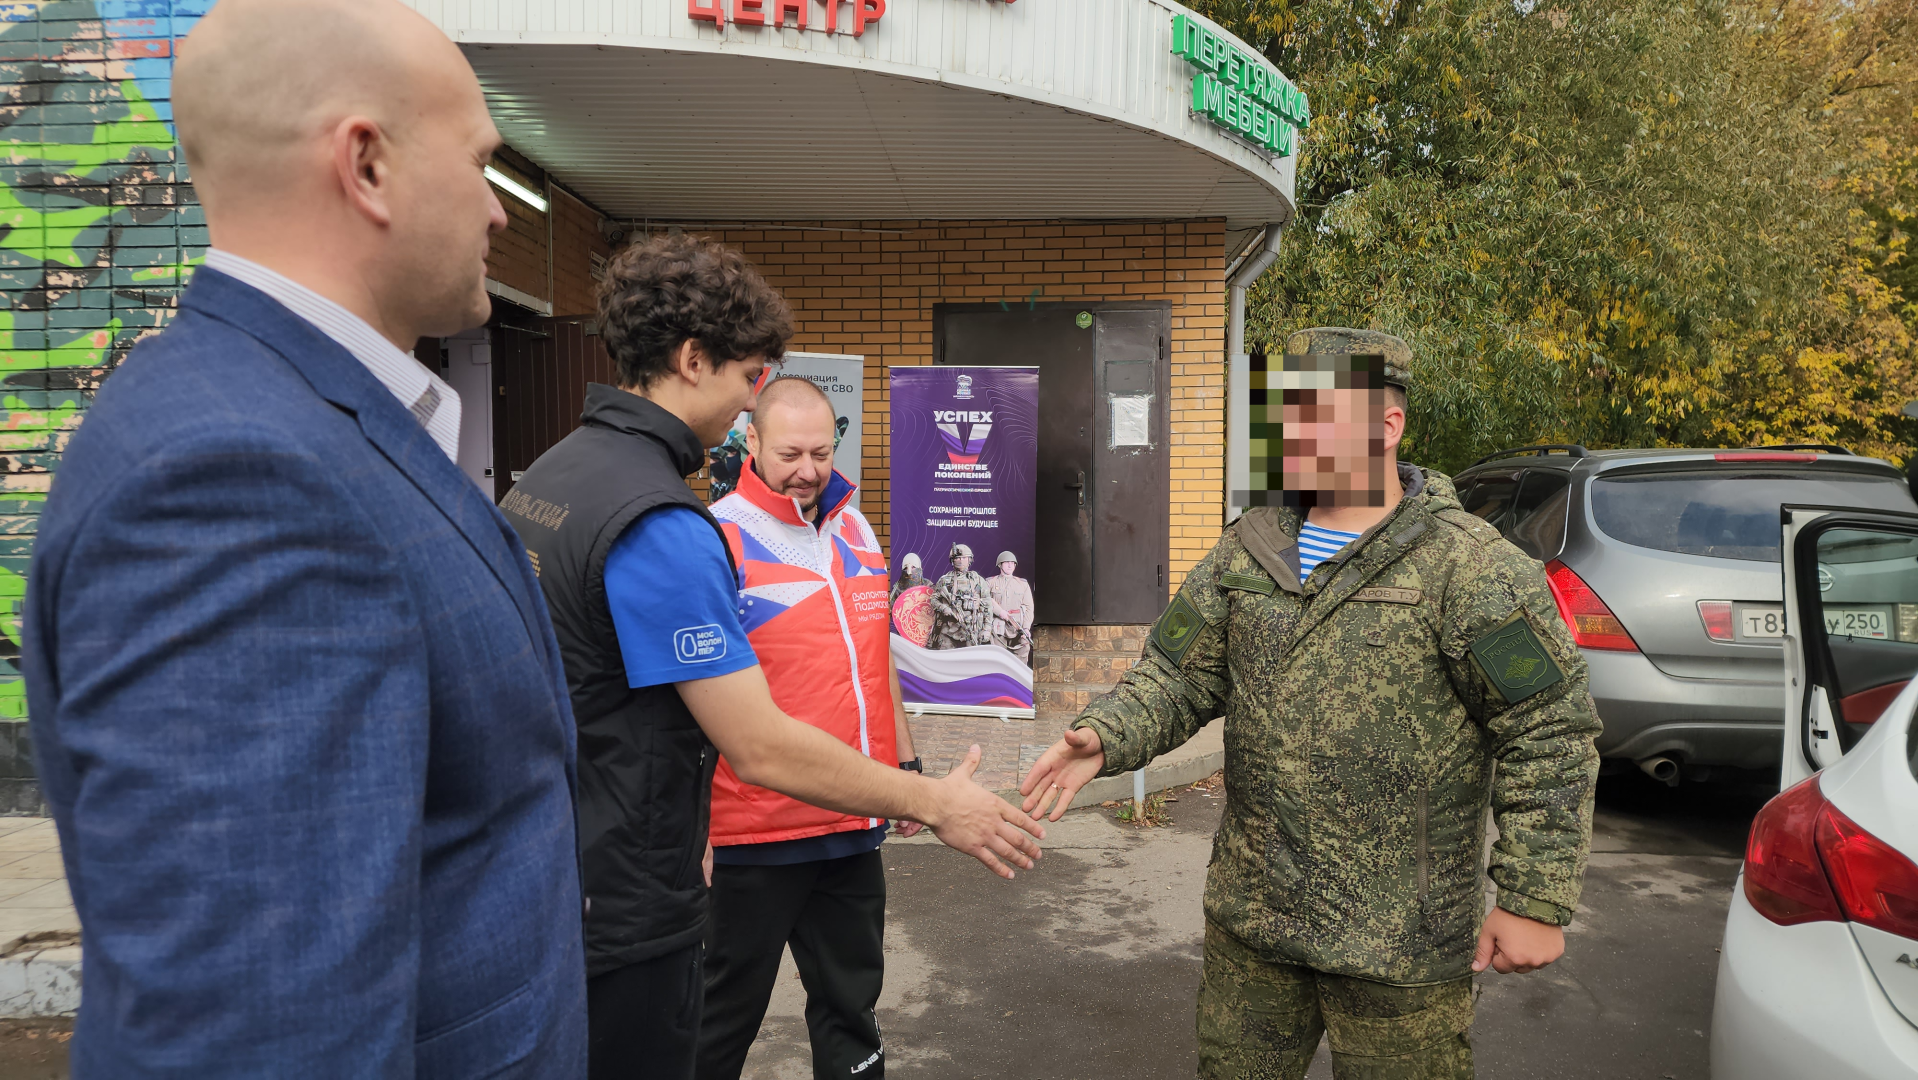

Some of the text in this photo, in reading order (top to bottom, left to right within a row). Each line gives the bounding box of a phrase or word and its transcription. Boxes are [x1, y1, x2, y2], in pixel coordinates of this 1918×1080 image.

[688, 0, 886, 37] ЦЕНТР
[1173, 14, 1310, 128] ПЕРЕТЯЖКА
[1193, 73, 1292, 157] МЕБЕЛИ
[831, 384, 854, 393] СВО
[933, 410, 993, 423] УСПЕХ
[938, 463, 989, 471] ЕДИНСТВЕ
[934, 471, 992, 479] ПОКОЛЕНИЙ
[928, 506, 997, 515] СОХРАНЯЯ ПРОШЛОЕ
[926, 518, 999, 529] ЗАЩИЩАЕМ БУДУЩЕЕ
[1845, 614, 1880, 630] 250
[696, 631, 715, 640] МОС
[1854, 629, 1872, 637] RUS
[697, 637, 723, 647] ВОЛОН
[1488, 635, 1525, 659] РОССИЯ
